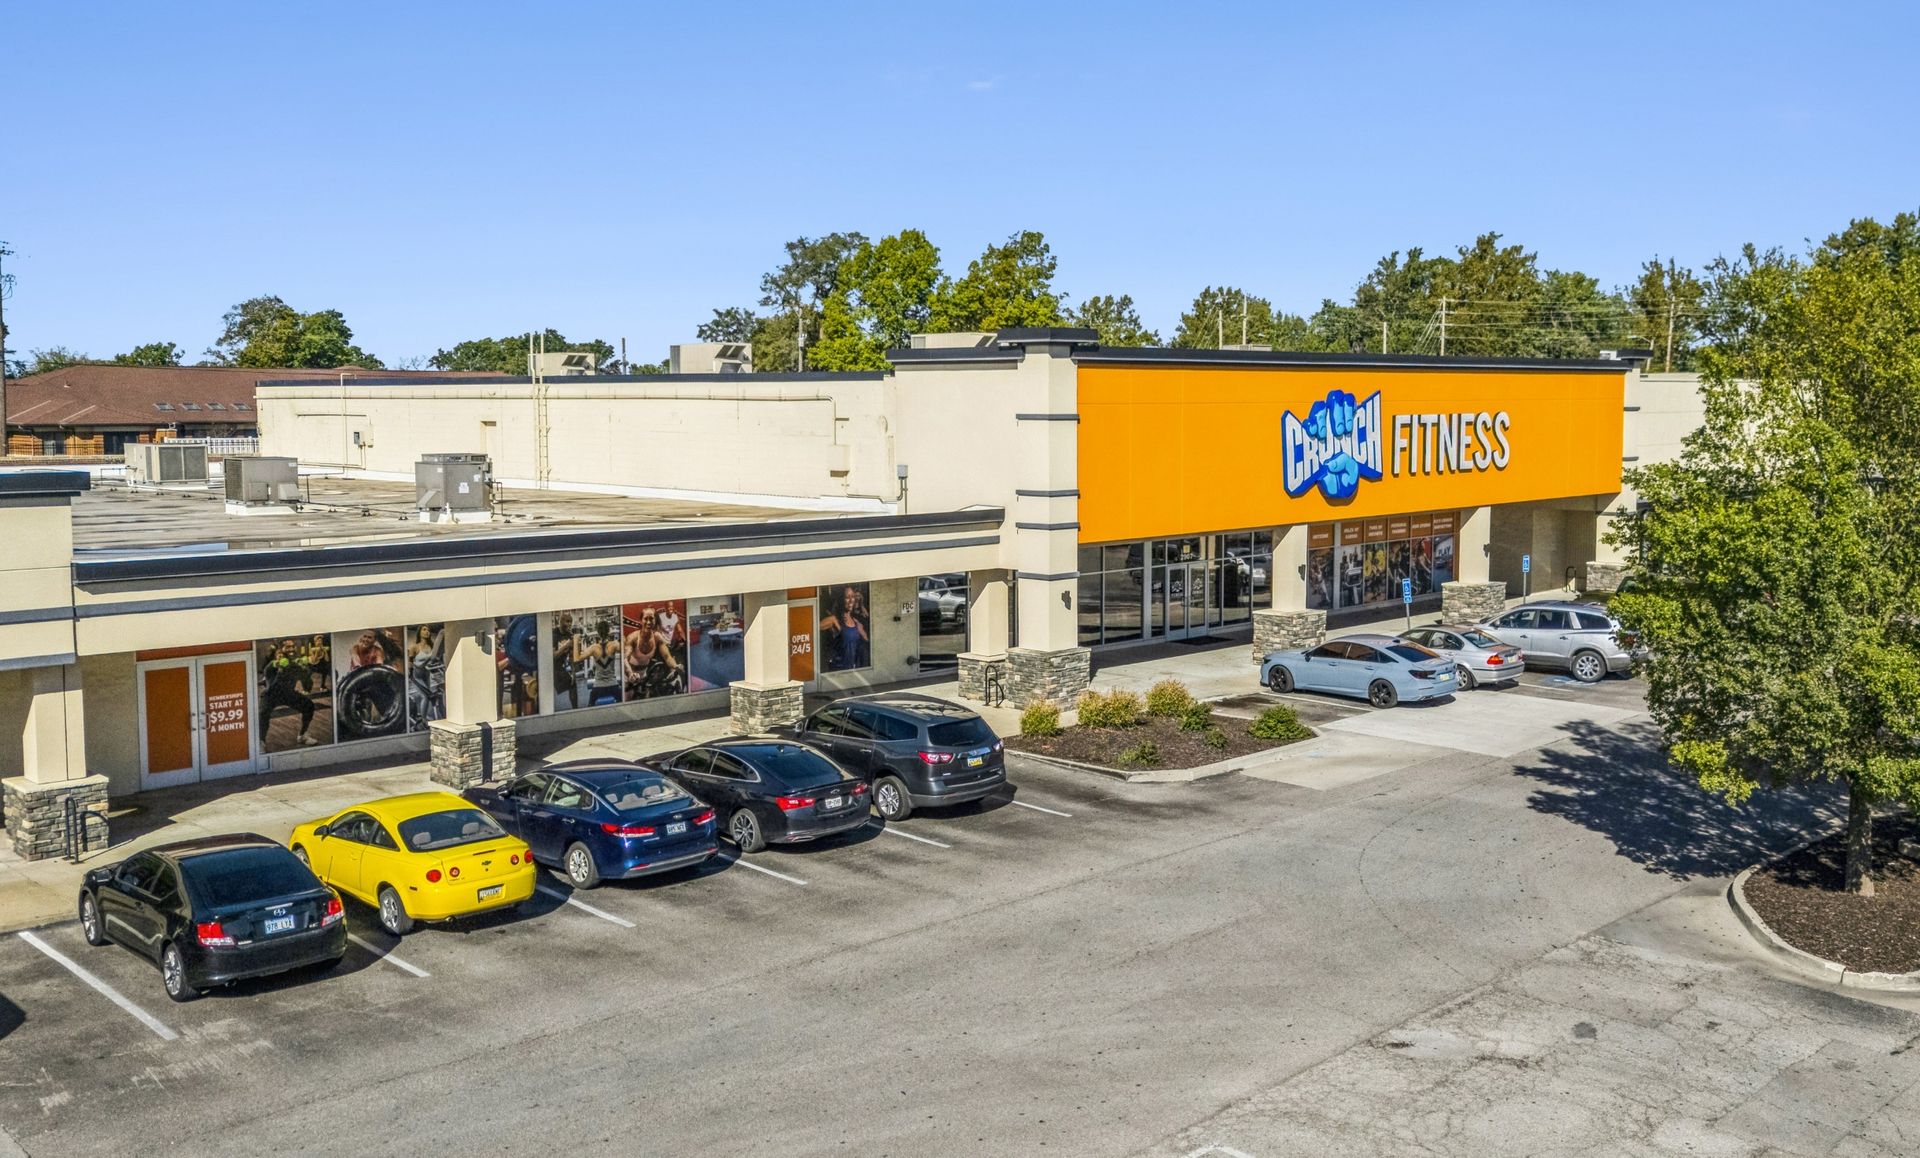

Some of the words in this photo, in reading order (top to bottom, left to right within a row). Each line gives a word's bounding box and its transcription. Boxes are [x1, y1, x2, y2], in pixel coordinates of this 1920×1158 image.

[1393, 411, 1510, 476] FITNESS
[902, 602, 914, 610] FDC
[792, 634, 810, 643] OPEN
[792, 643, 811, 655] 24/5
[209, 701, 232, 709] START
[210, 709, 243, 723] $9.99
[218, 722, 244, 731] MONTH
